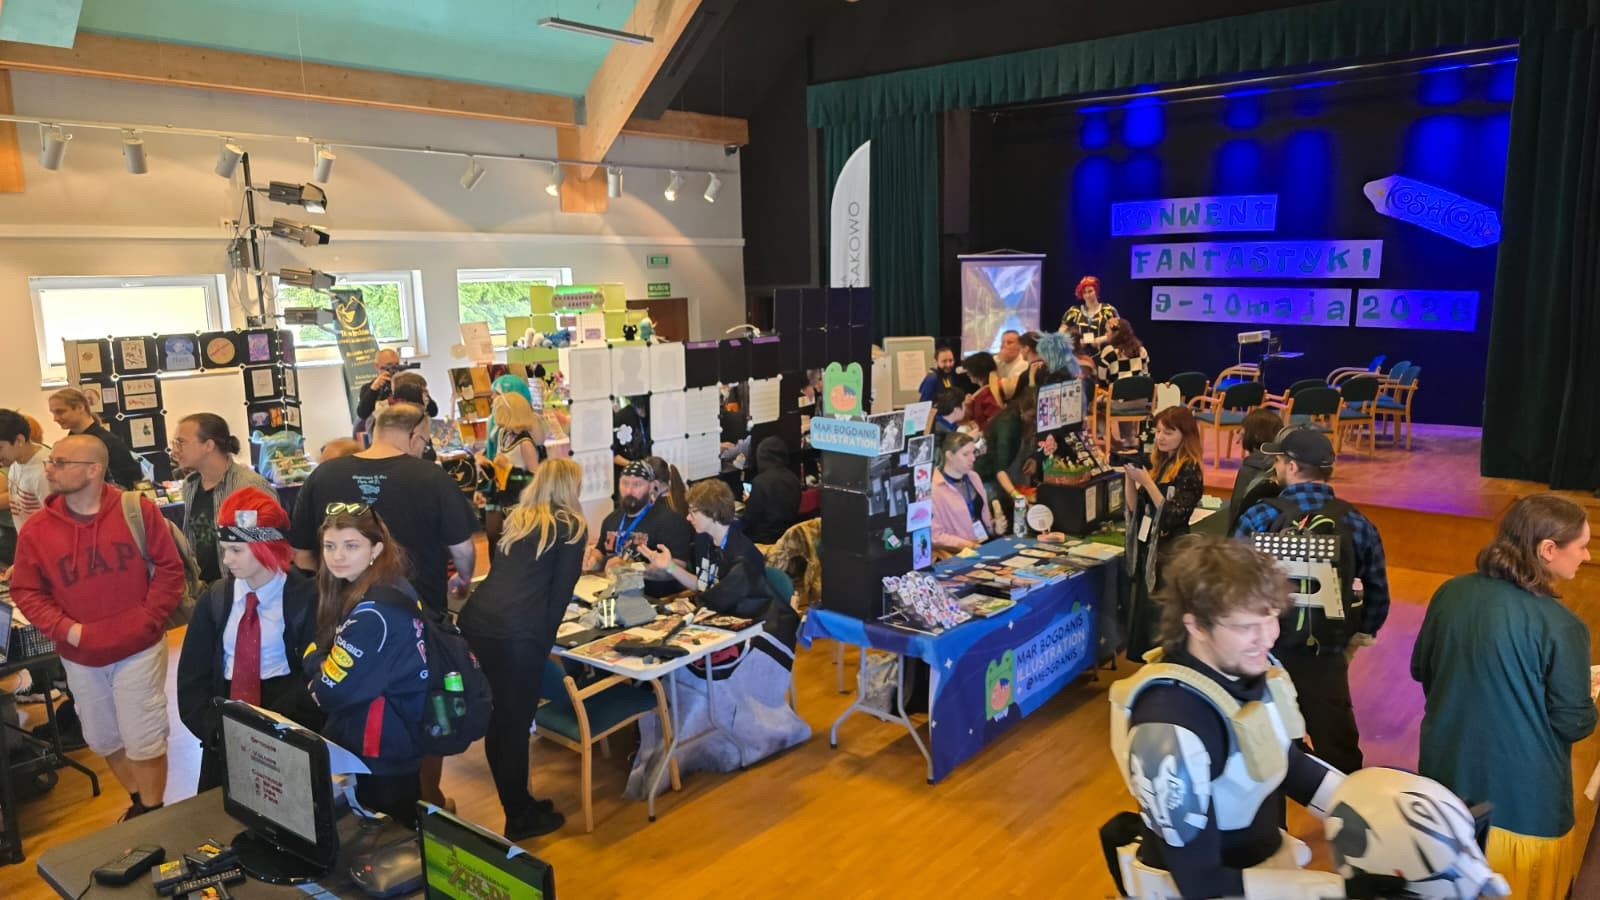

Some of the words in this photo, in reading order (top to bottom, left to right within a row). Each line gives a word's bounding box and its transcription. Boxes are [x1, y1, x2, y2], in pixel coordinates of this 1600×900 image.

[1113, 200, 1274, 232] KONWENT
[847, 201, 862, 288] SAKOWO
[1133, 246, 1372, 273] FANTASTYKI
[813, 421, 832, 433] MAR
[833, 424, 877, 439] BOGDANIS
[813, 431, 878, 449] ILLUSTRATION
[57, 541, 136, 588] GAP
[1016, 643, 1037, 664] MAR
[1040, 613, 1083, 652] BOGDANIS
[1017, 630, 1085, 682] ILLUSTRATION
